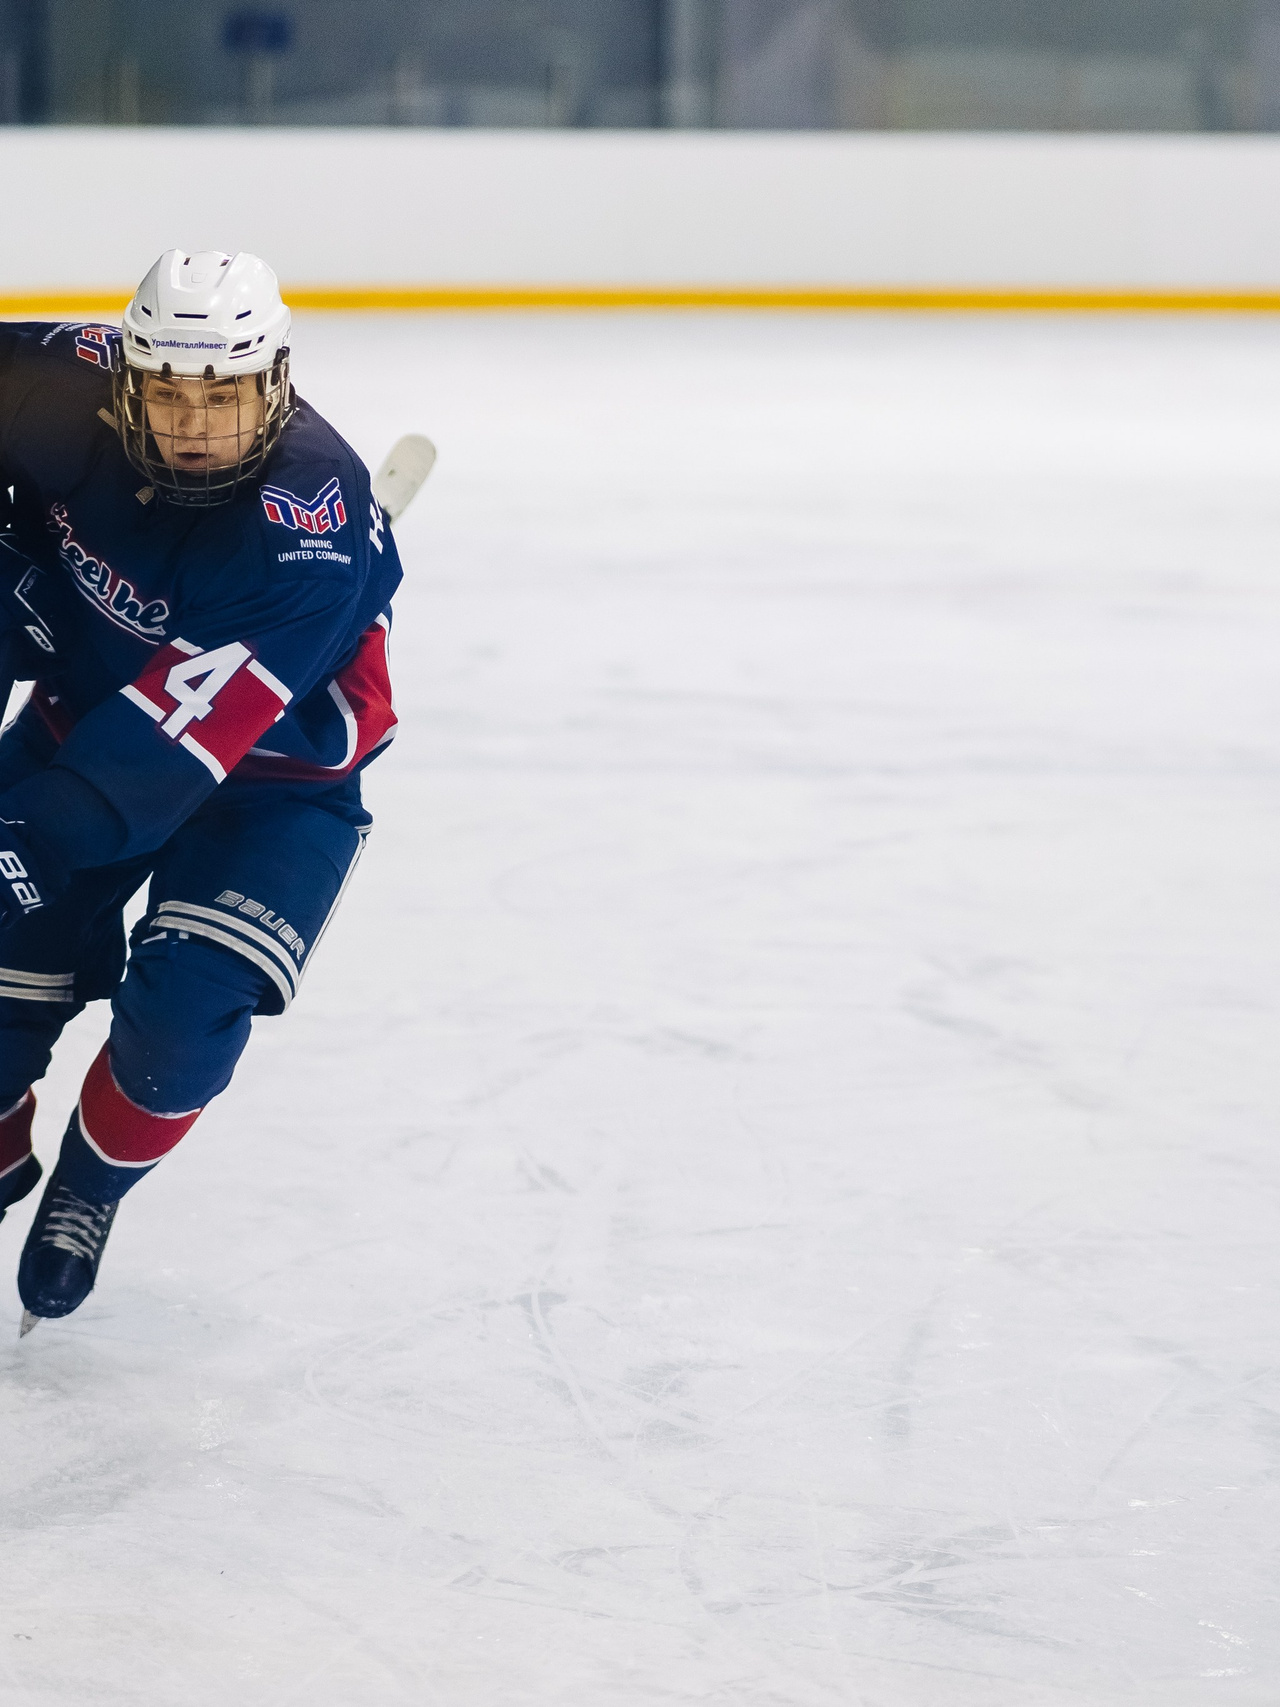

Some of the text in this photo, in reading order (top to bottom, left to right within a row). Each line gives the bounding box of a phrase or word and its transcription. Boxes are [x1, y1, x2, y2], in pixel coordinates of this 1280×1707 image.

[151, 338, 228, 350] УралМеталлИнвест
[299, 538, 333, 550] MINING
[277, 550, 352, 565] UNITED COMPANY
[161, 641, 252, 740] 4
